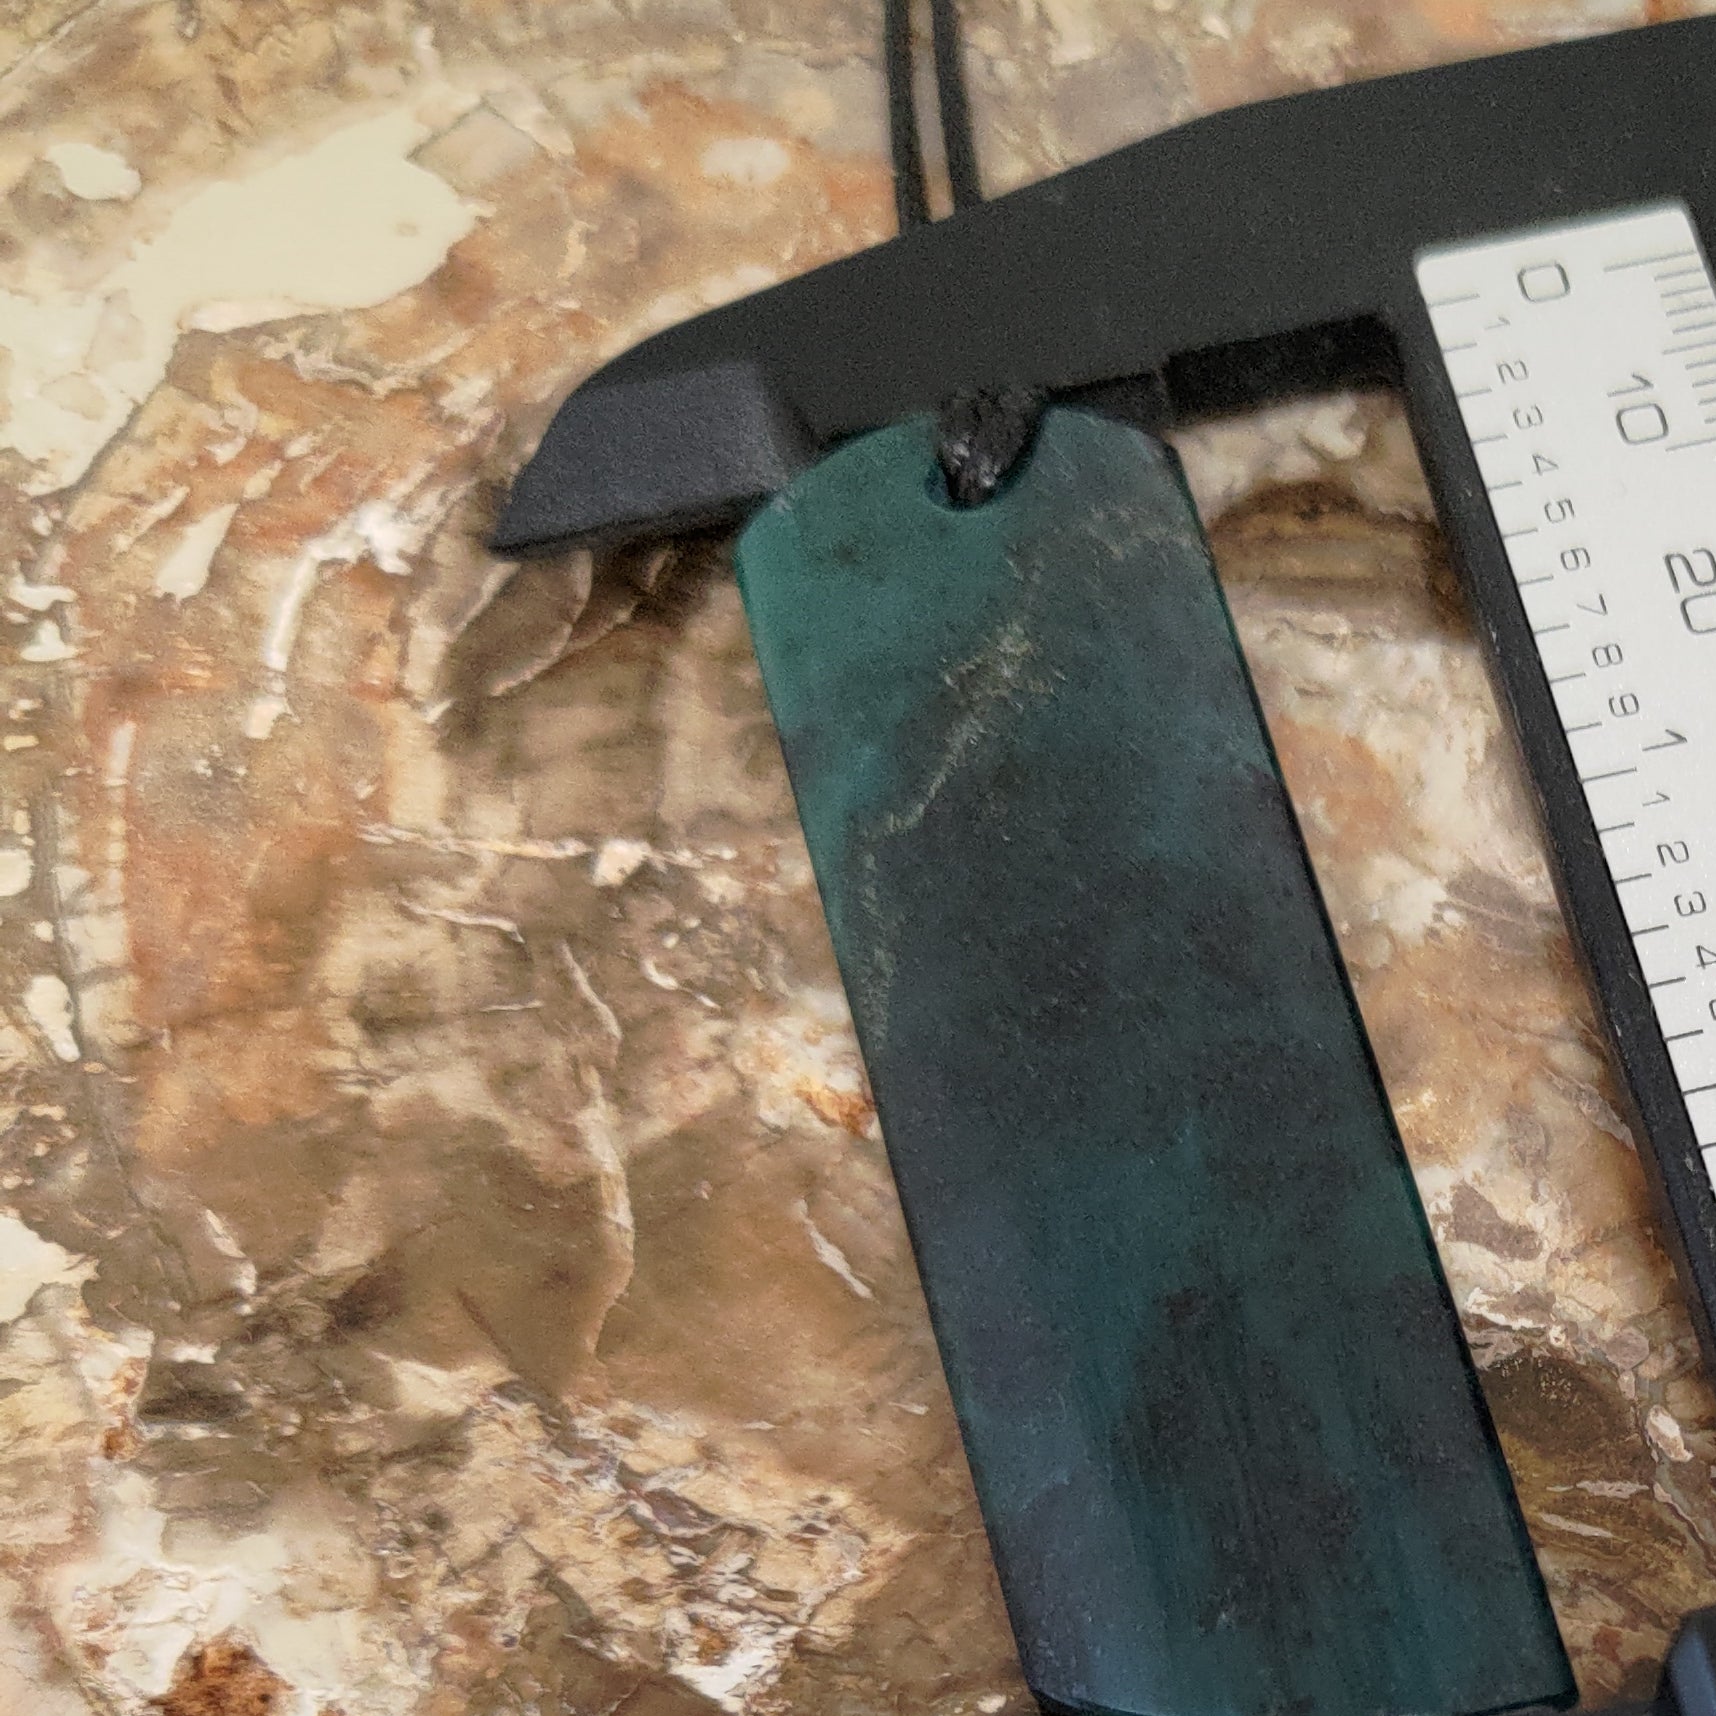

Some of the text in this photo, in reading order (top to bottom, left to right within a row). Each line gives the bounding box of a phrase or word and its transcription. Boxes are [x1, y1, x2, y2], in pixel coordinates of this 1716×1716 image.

[1485, 315, 1510, 329] 1
[1517, 262, 1571, 302] 0
[1607, 372, 1669, 445] 10
[1496, 360, 1528, 383] 2
[1513, 405, 1543, 428] 3
[1532, 454, 1558, 475] 4
[1544, 499, 1574, 522] 5
[1560, 548, 1590, 570] 6
[1578, 594, 1607, 614] 7
[1592, 644, 1623, 667] 8
[1609, 693, 1639, 716] 9
[1643, 729, 1687, 751] 1
[1643, 792, 1670, 806] 1
[1657, 841, 1689, 866] 2
[1674, 892, 1706, 916] 3
